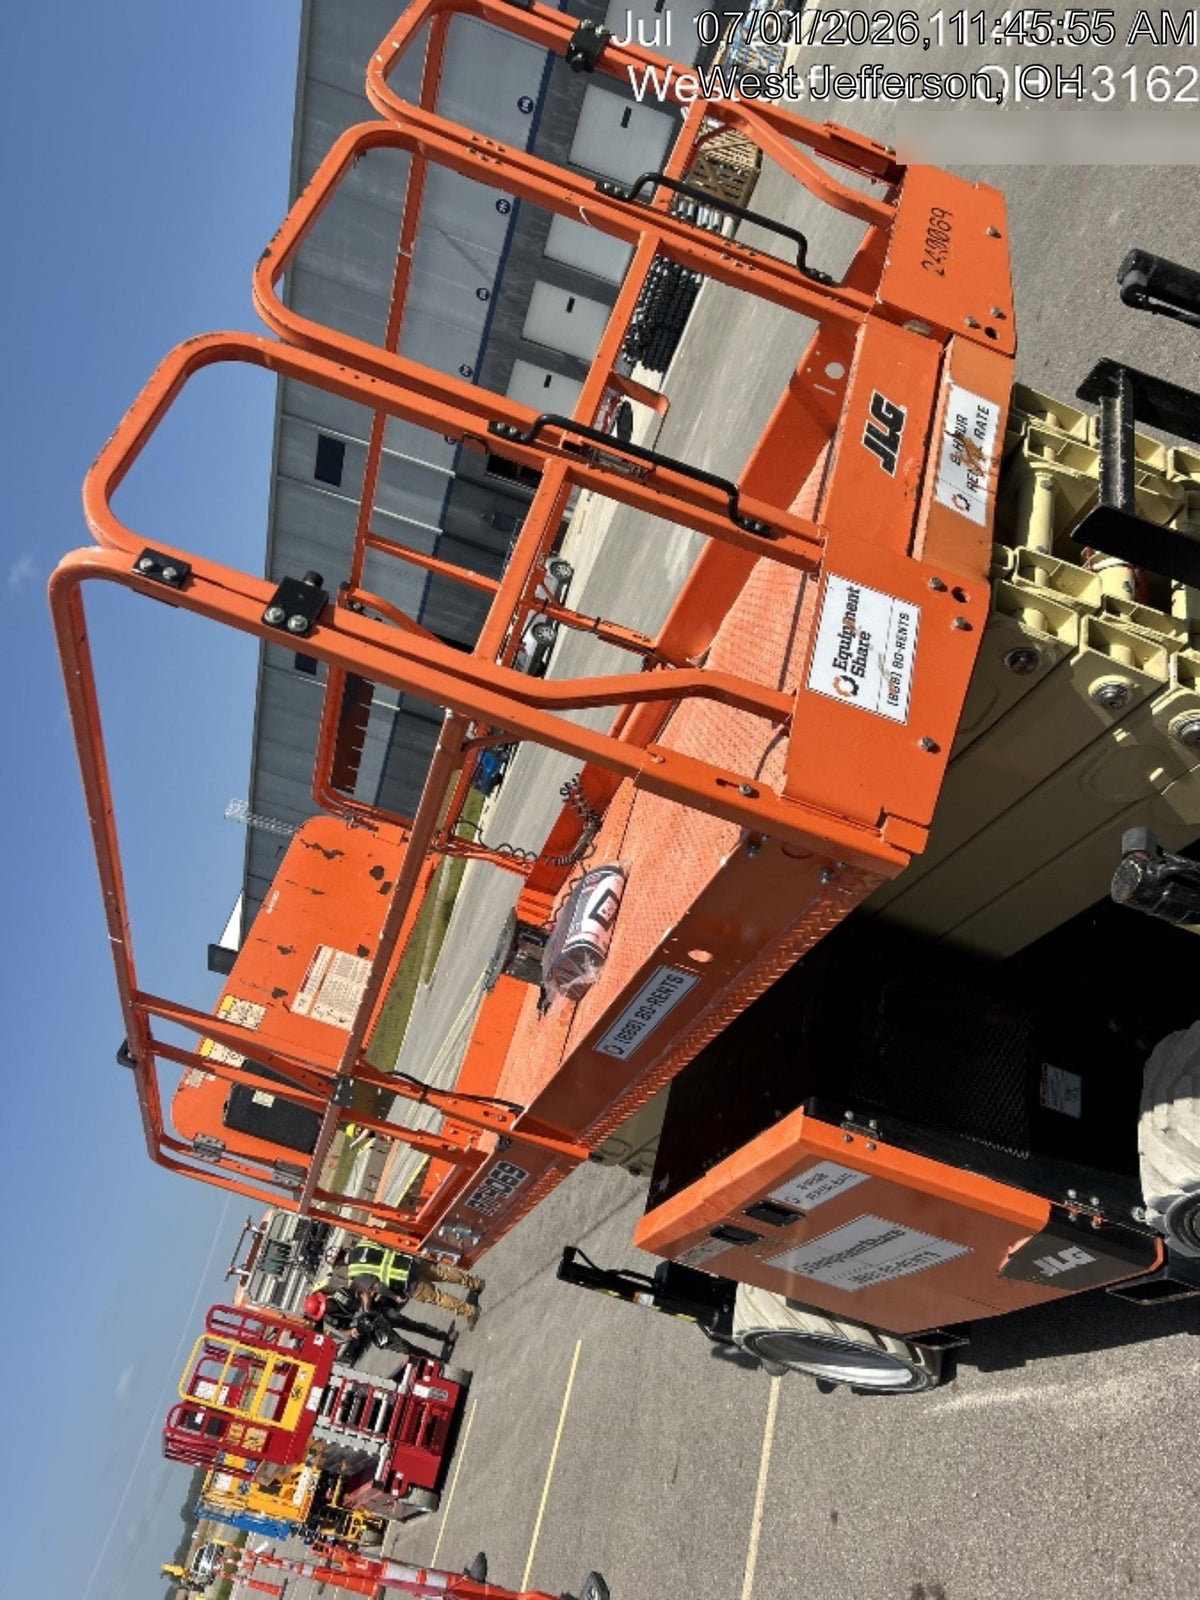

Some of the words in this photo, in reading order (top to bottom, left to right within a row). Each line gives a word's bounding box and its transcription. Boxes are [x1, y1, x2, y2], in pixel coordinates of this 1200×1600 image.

[860, 389, 908, 478] JLG
[973, 404, 991, 442] RATE
[850, 630, 872, 678] Share
[1030, 1245, 1098, 1279] JLG
